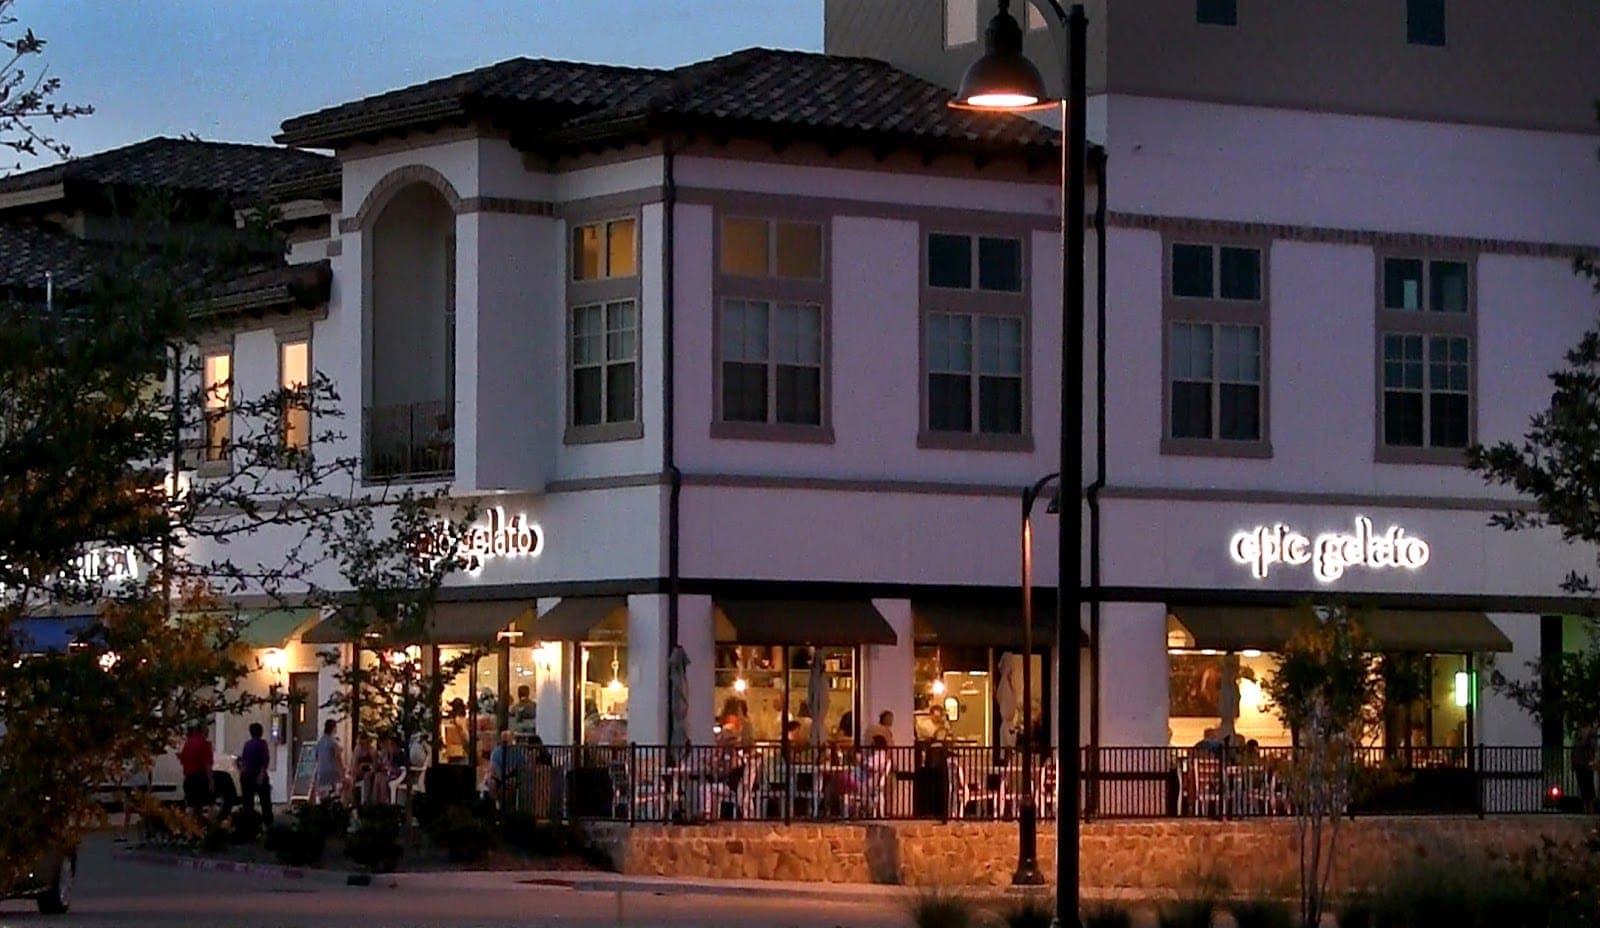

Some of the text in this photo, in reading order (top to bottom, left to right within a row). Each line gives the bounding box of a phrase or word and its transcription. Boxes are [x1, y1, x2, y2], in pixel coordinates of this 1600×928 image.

[456, 506, 544, 576] gelato
[1230, 516, 1430, 581] epic gelato
